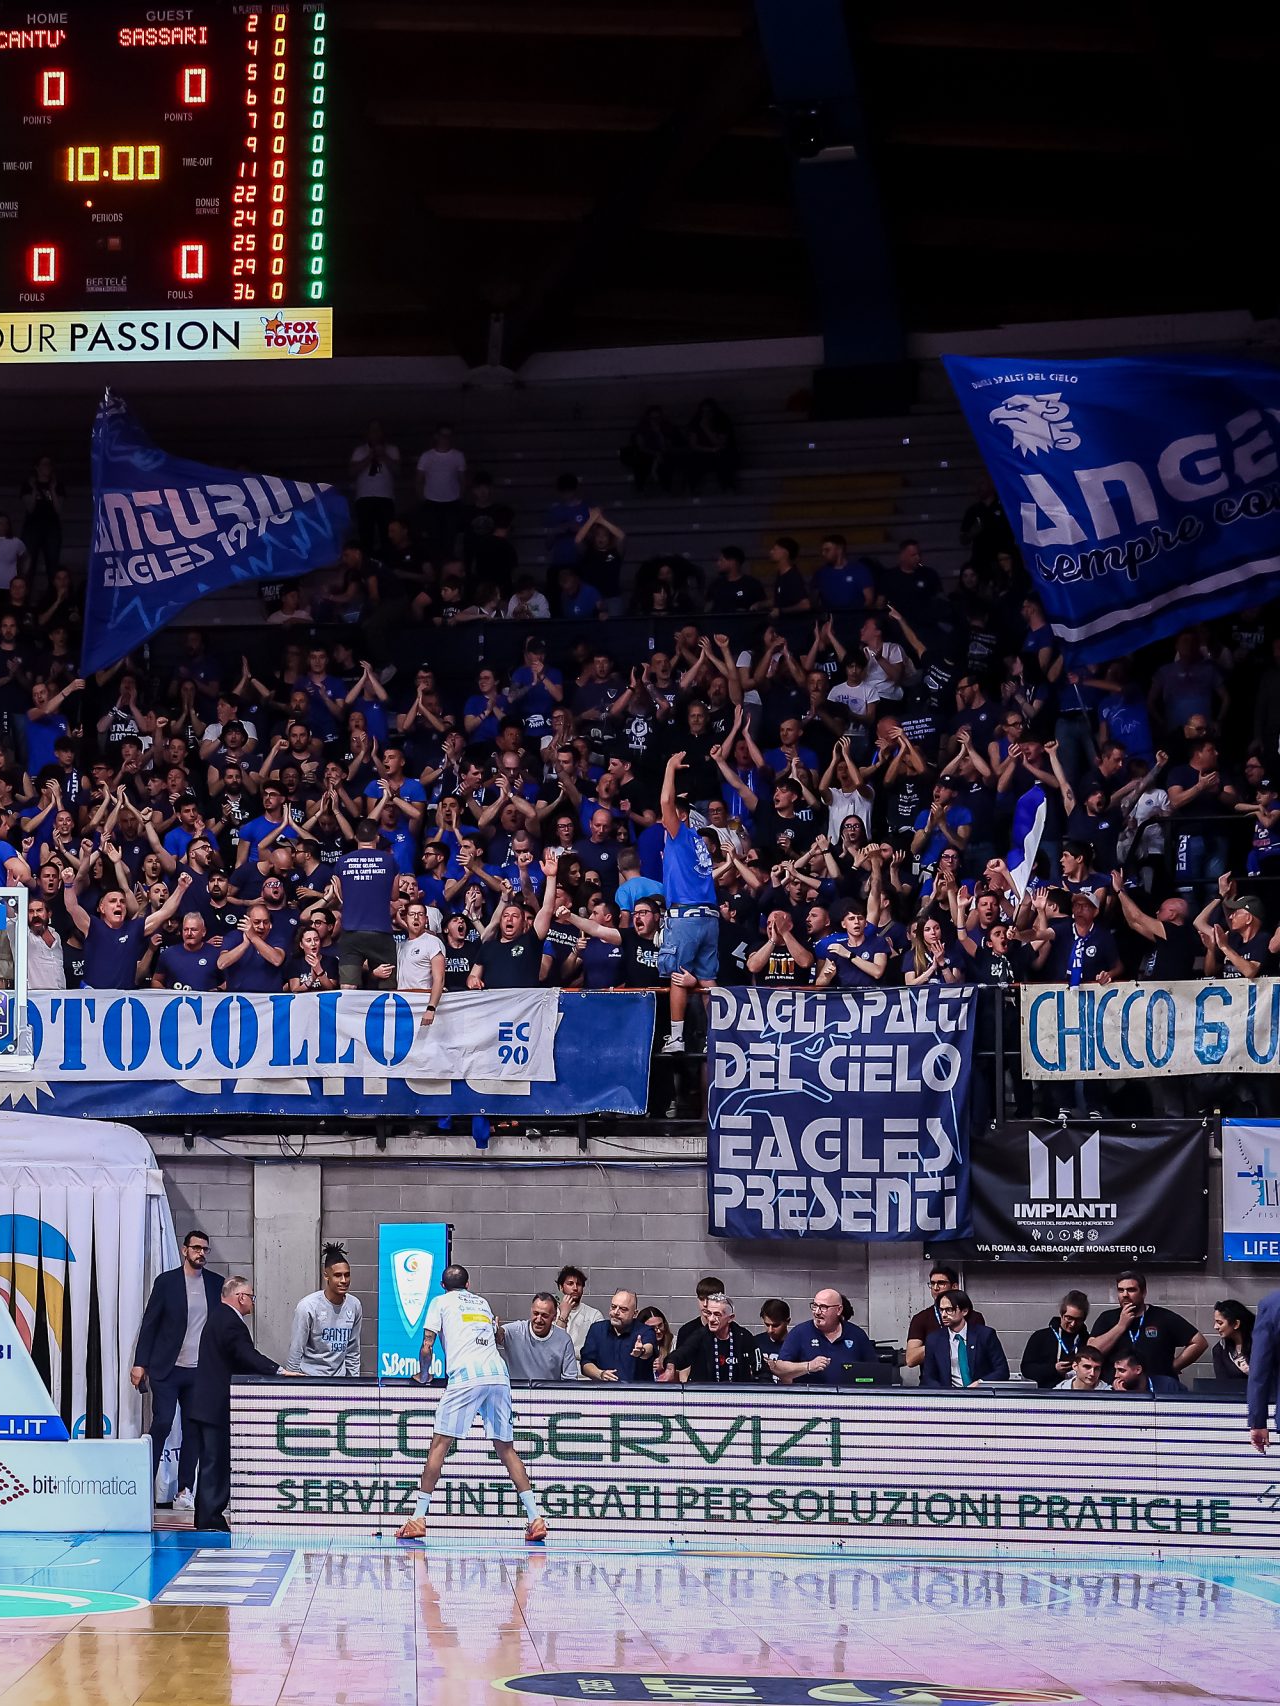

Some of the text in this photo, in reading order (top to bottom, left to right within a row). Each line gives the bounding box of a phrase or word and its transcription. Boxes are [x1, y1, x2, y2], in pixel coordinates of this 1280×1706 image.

[26, 13, 68, 25] HOME
[146, 10, 193, 22] GUEST
[247, 14, 258, 32] 2
[119, 27, 207, 46] SASSARI
[247, 39, 258, 56] 4
[247, 63, 257, 81] 5
[43, 71, 65, 106] 0
[185, 68, 206, 103] 0
[246, 88, 257, 106] 6
[23, 115, 52, 125] POINTS
[164, 112, 193, 121] POINTS
[248, 112, 258, 129] 7
[246, 136, 257, 153] 9
[2, 161, 33, 171] TIME-OUT
[68, 146, 160, 181] 10.00
[182, 157, 213, 167] TIME-OUT
[240, 161, 257, 178] 11
[195, 198, 220, 207] BONUS
[233, 185, 257, 204] 22
[91, 213, 123, 222] PERIODS
[233, 209, 257, 228] 24
[232, 234, 256, 252] 25
[33, 247, 55, 282] 0
[181, 245, 203, 279] 0
[232, 258, 256, 276] 29
[20, 293, 45, 302] FOULS
[167, 290, 193, 300] FOULS
[233, 283, 255, 300] 36
[71, 321, 240, 351] PASSION
[284, 321, 317, 334] FOX
[265, 332, 318, 347] TOWN
[1027, 373, 1046, 381] DEL
[1020, 408, 1280, 547] ANGE
[104, 546, 214, 587] EAGLES
[710, 986, 975, 1034] DAGLI SPALTI
[498, 1022, 531, 1043] EC
[1028, 989, 1176, 1071] CHICCO
[498, 1045, 530, 1066] 90
[715, 1042, 962, 1092] DEL CIELO
[719, 1115, 953, 1173] EAGLES
[713, 1174, 957, 1233] PRESENTI
[1013, 1203, 1117, 1218] IMPIANTI
[977, 1244, 1156, 1254] VIA ROMA 38, GARBAGNATE MONASTERO (LC)
[677, 1485, 752, 1521] PER
[766, 1488, 1002, 1527] SOLUZIONI
[1018, 1494, 1232, 1534] PRATICHE
